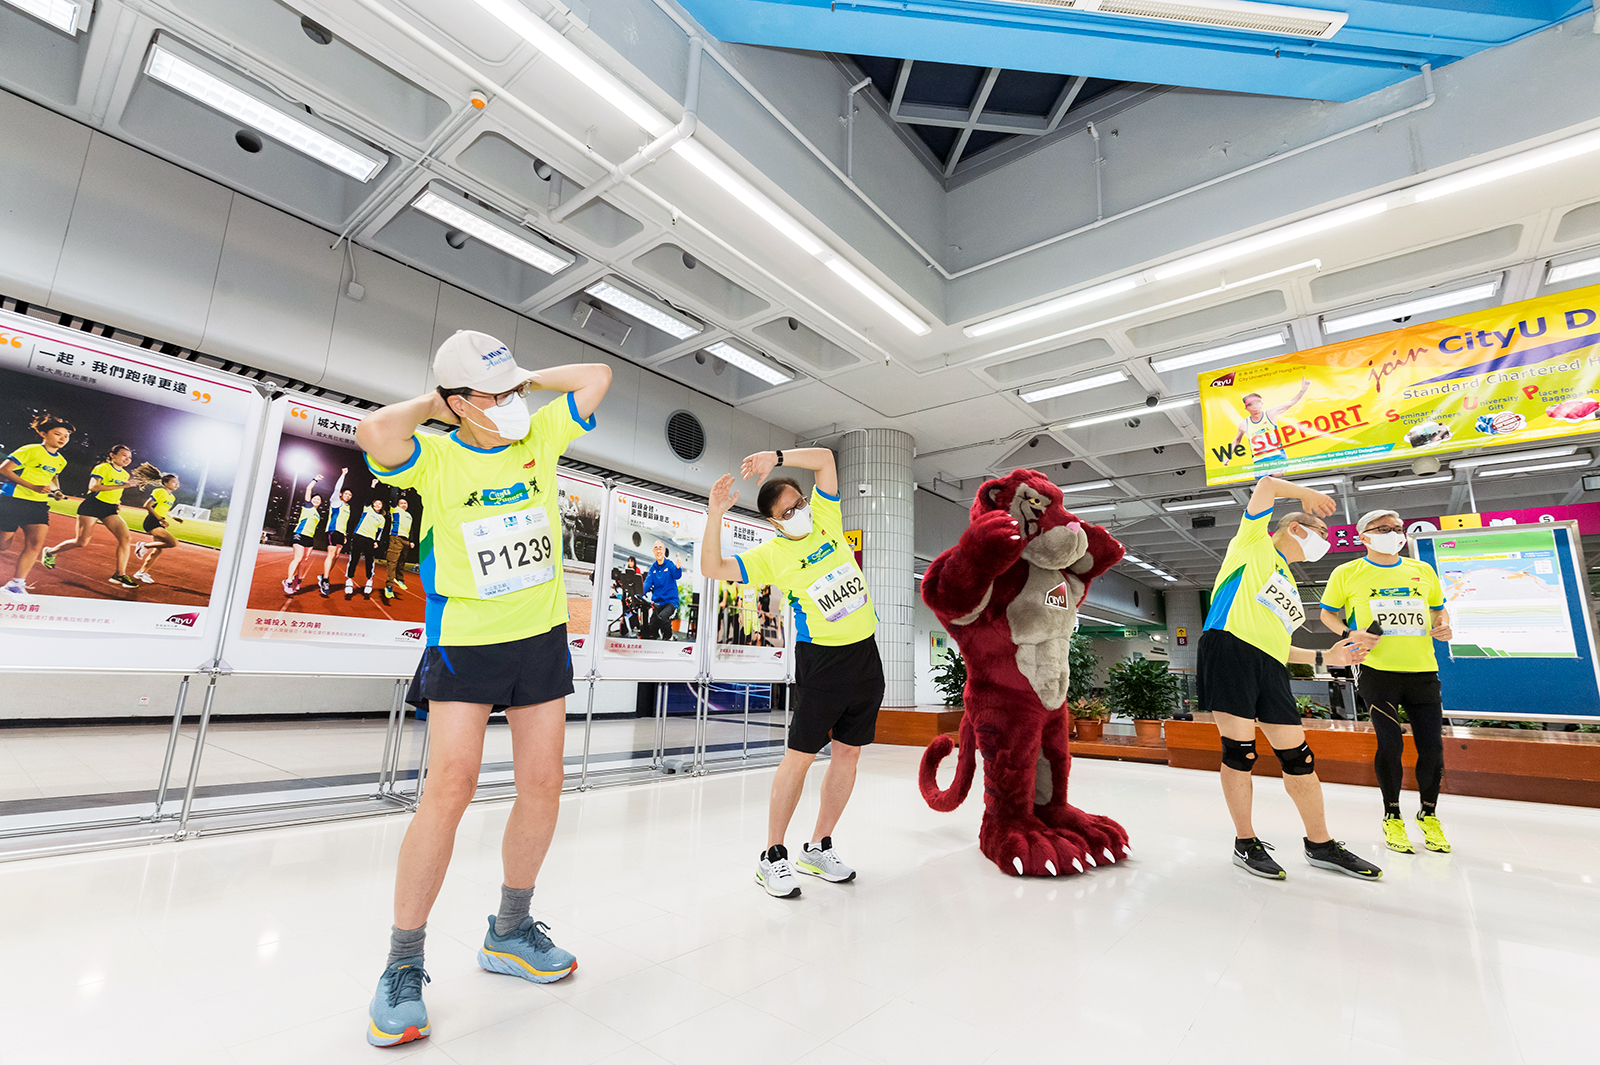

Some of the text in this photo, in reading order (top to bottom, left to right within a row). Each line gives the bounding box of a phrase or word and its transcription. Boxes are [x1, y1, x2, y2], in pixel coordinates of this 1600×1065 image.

[39, 350, 187, 395] 一起，我們跑得更遠
[1368, 347, 1428, 393] join
[1438, 316, 1548, 355] CityU
[1403, 378, 1480, 400] Standard
[1486, 358, 1581, 385] Chartered
[1212, 442, 1246, 463] We
[1250, 403, 1363, 452] SUPPORT
[1403, 417, 1424, 426] CityU
[489, 489, 511, 501] CityU
[477, 535, 551, 577] P1239
[0, 602, 40, 613] 力向前
[817, 576, 864, 612] M4462
[1265, 584, 1303, 622] P2367
[290, 620, 322, 629] 全力向前
[1377, 612, 1424, 626] P2076
